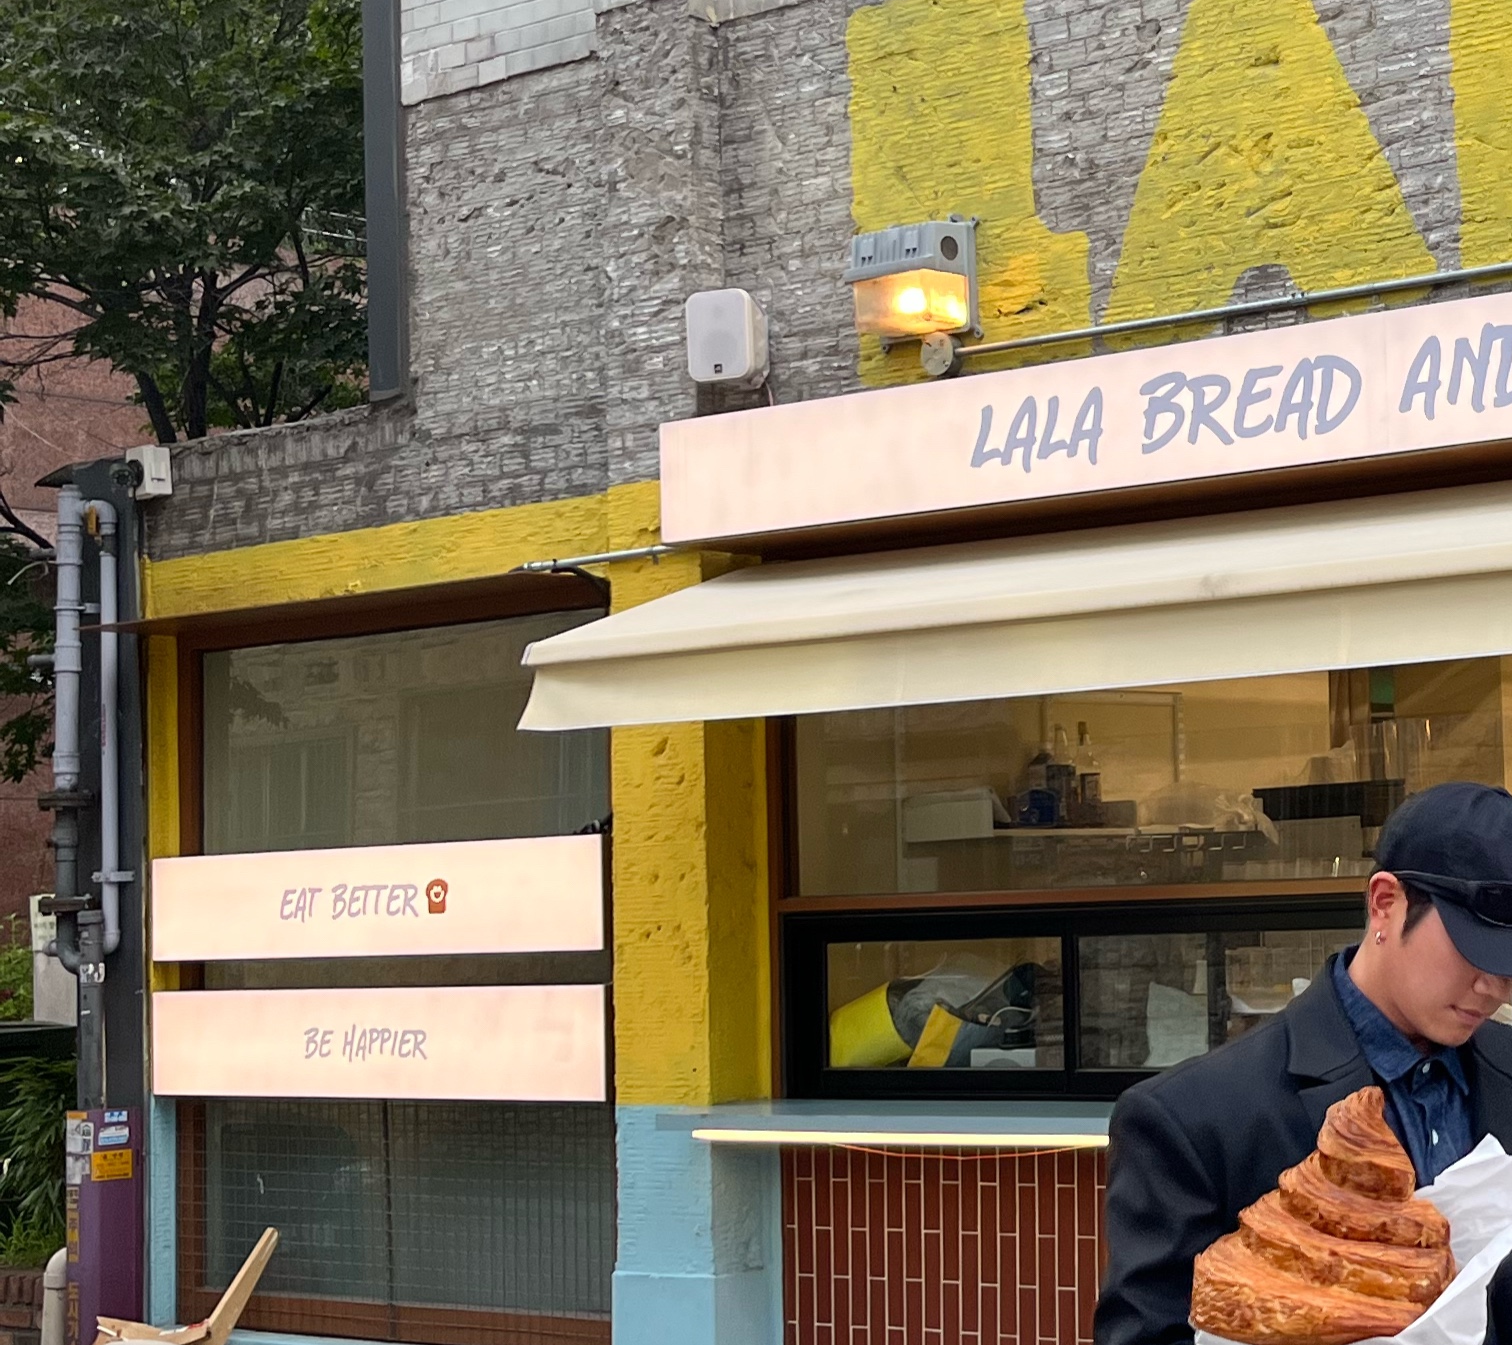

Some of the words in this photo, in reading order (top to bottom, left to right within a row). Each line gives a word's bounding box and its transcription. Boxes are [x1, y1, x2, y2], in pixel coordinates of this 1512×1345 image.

[970, 387, 1103, 473] LALA
[1139, 354, 1362, 454] BREAD
[279, 887, 323, 924] EAT
[331, 883, 419, 921] BETTER
[303, 1027, 335, 1060] BE
[342, 1023, 428, 1064] HAPPIER
